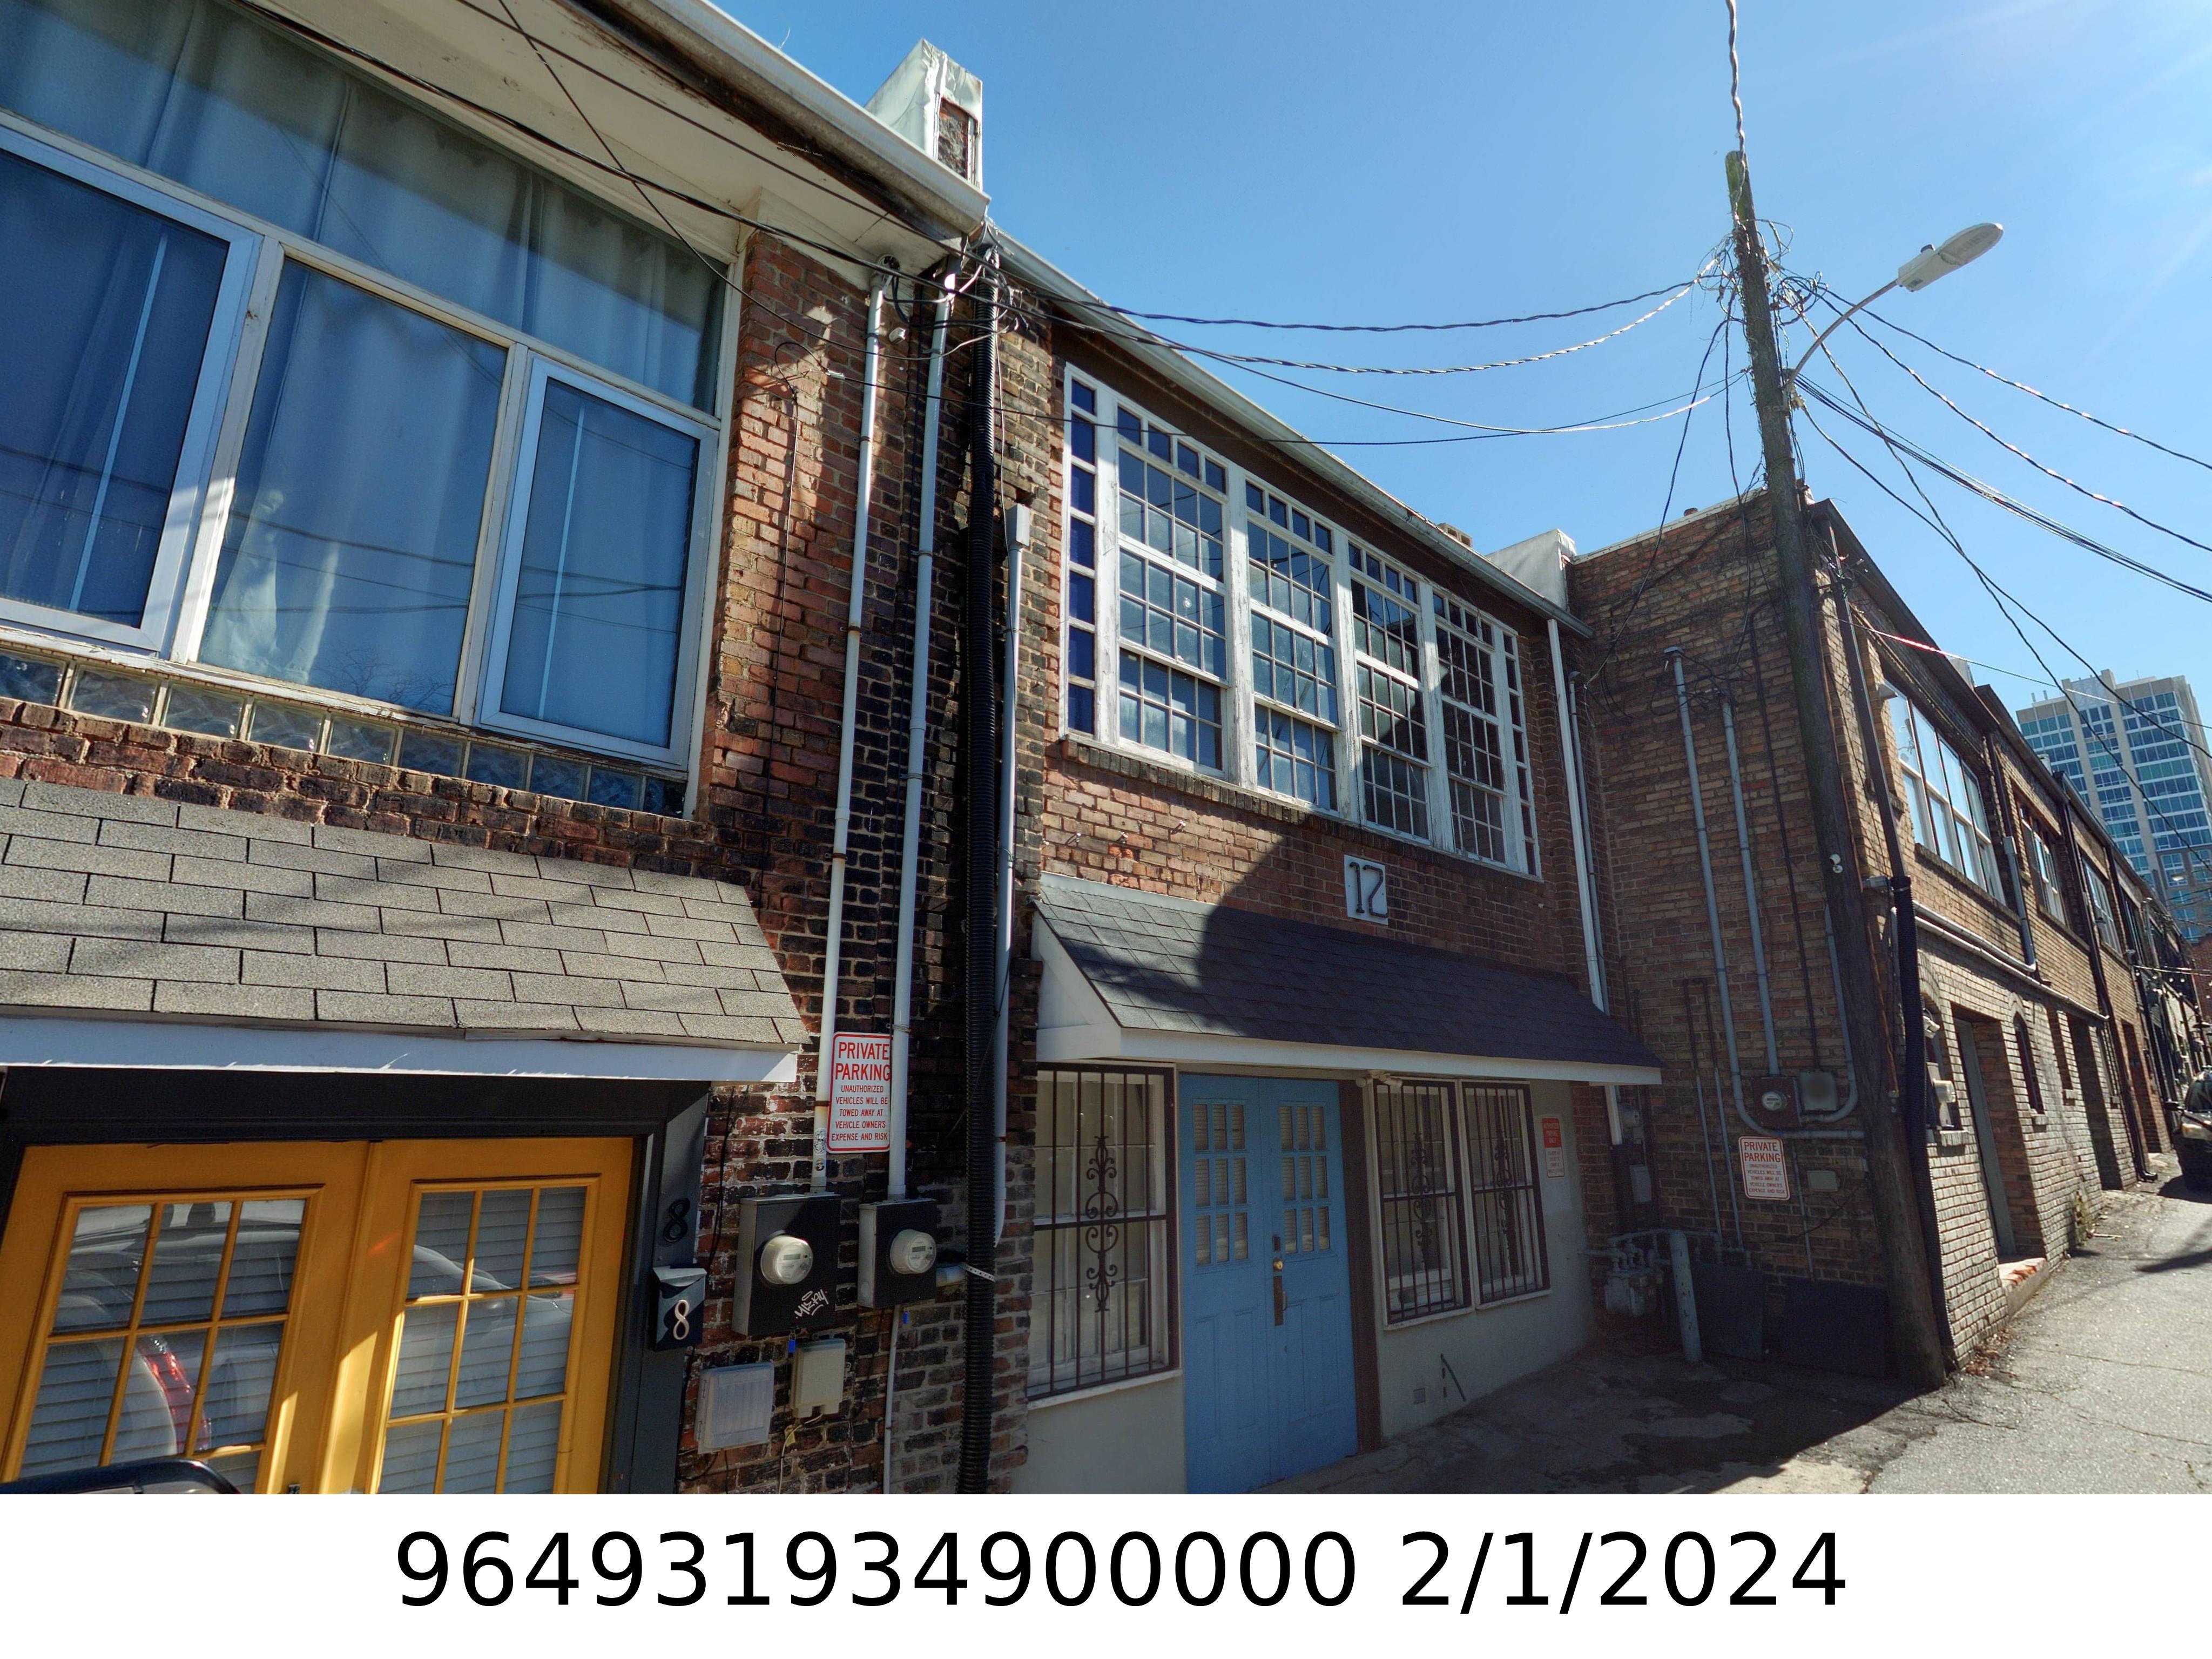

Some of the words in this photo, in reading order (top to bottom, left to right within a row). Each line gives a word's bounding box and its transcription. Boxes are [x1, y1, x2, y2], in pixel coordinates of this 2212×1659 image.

[1349, 861, 1389, 918] 12
[838, 1042, 890, 1060] PRIVATE
[835, 1063, 891, 1081] PARKING
[831, 1133, 858, 1141] EXPENSE
[875, 1132, 888, 1141] RISK
[1744, 1142, 1778, 1151] PRIVATE
[1744, 1152, 1781, 1163] PARKING
[663, 1198, 690, 1242] 8
[673, 1299, 690, 1340] 8
